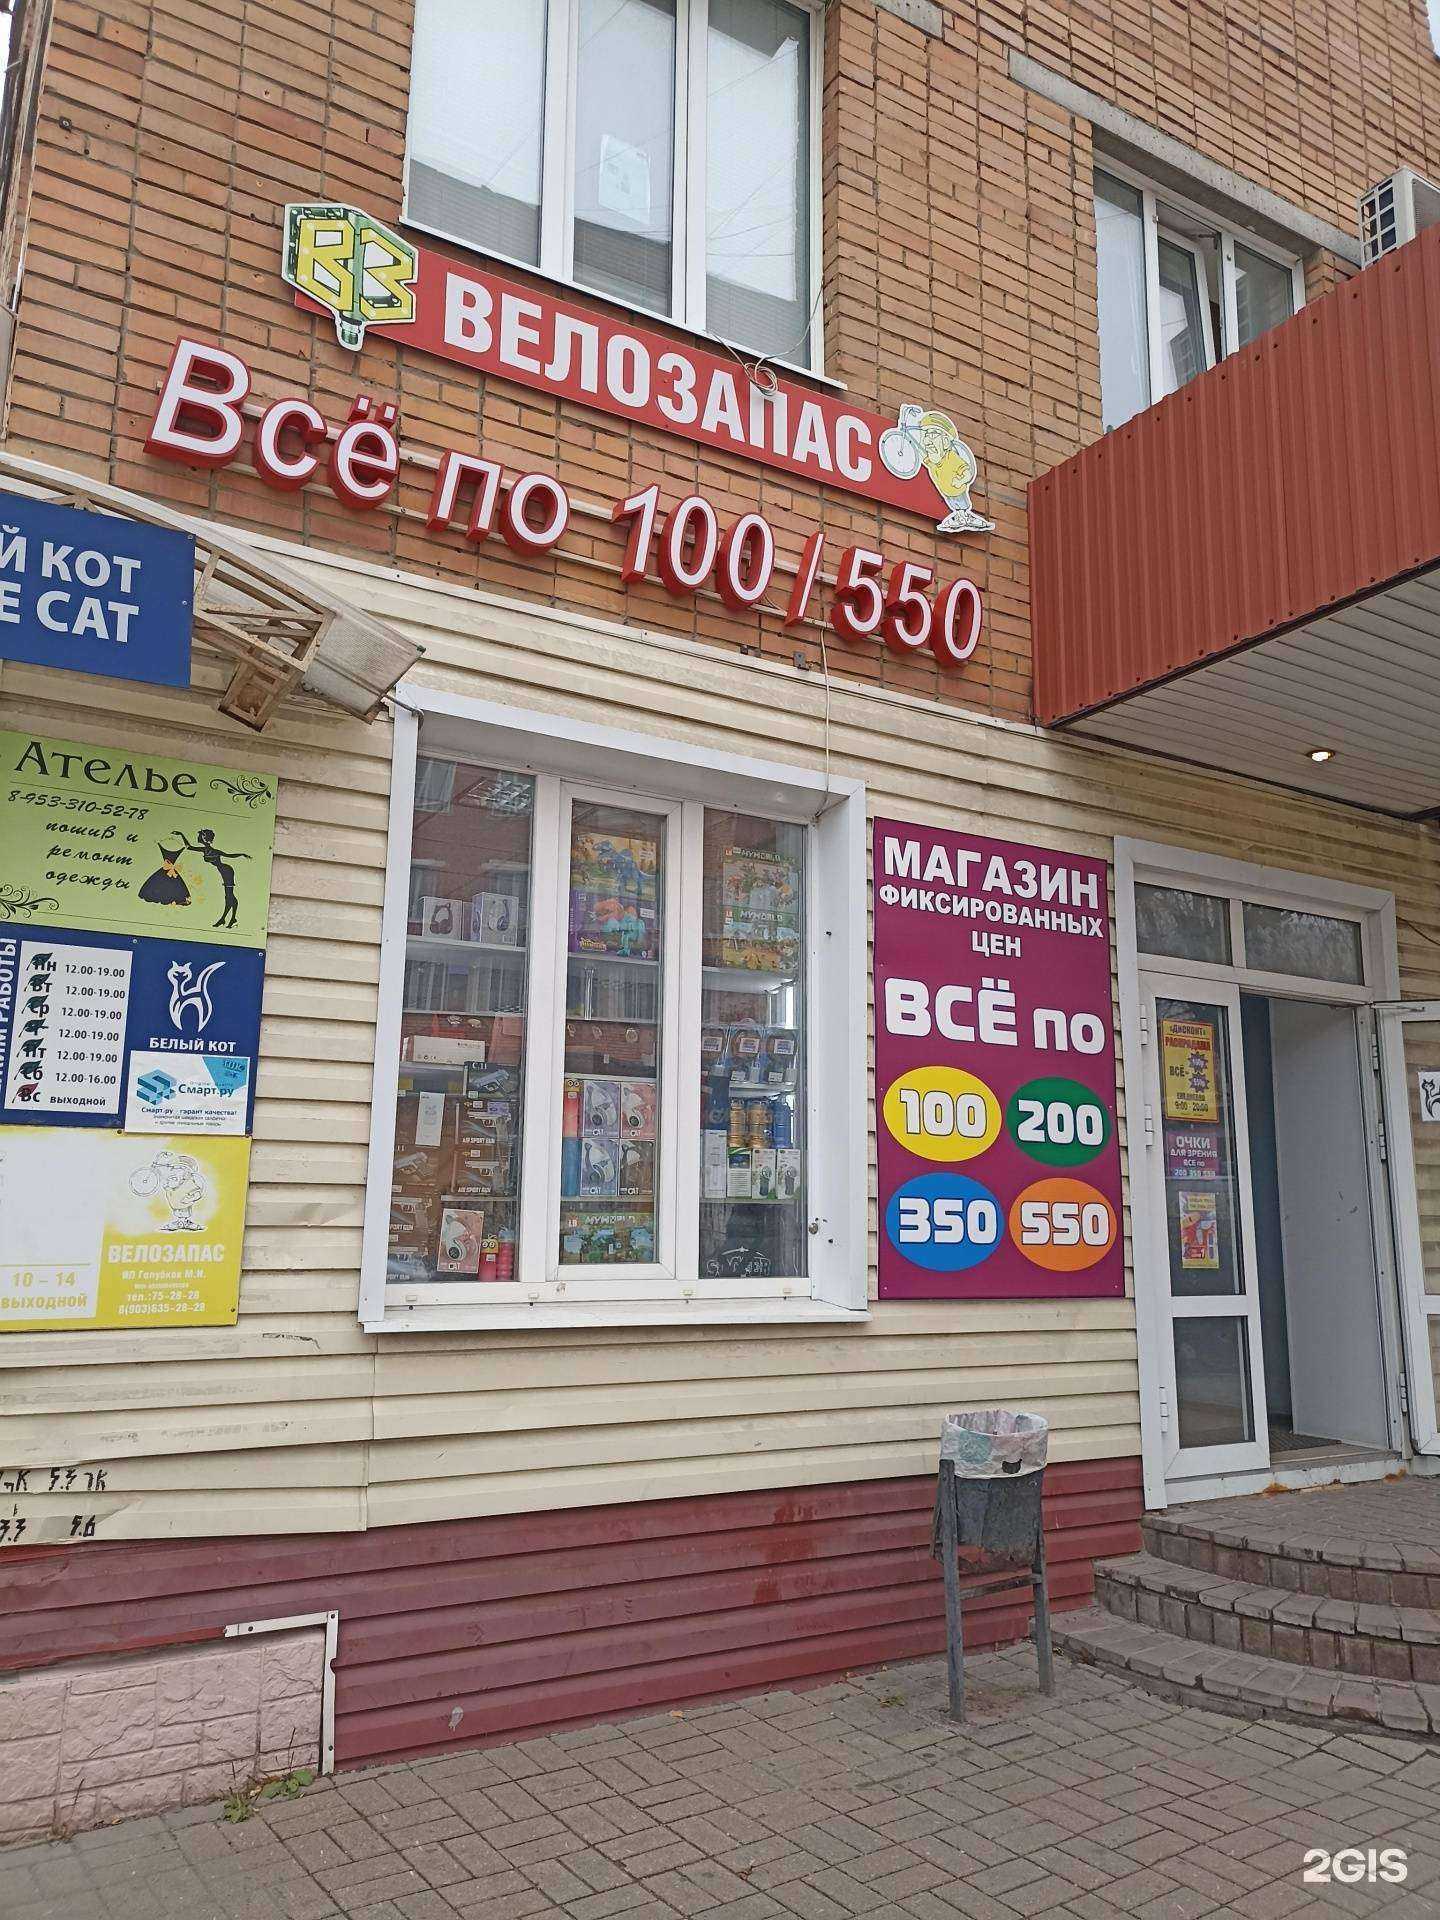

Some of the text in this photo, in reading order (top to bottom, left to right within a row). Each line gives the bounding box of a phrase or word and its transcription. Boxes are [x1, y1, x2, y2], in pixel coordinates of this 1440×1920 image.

[444, 272, 872, 482] ВЕЛОЗАПАС
[146, 336, 399, 505] Всё
[431, 450, 570, 551] по
[42, 541, 142, 593] КОТ
[36, 590, 140, 643] CAT
[14, 741, 198, 799] Ателье
[8, 790, 150, 820] 8-953-310-52-78
[46, 821, 139, 843] пошив и
[47, 844, 133, 867] ремонт
[46, 870, 130, 890] одежды
[883, 836, 1100, 910] МАГАЗИН
[878, 884, 1104, 938] ФИКСИРОВАННЫХ
[971, 930, 1022, 959] ЦЕН
[65, 964, 125, 978] 12.00-19.00
[65, 985, 126, 999] 12.00-19.00
[61, 1007, 122, 1020] 12.00-19.00
[884, 978, 1019, 1046] ВСЁ
[58, 1028, 120, 1042] 12.00-19.00
[149, 1037, 236, 1053] БЕЛЫЙ КОТ
[57, 1050, 118, 1063] 12.00-19.00
[55, 1072, 116, 1085] 12.00-16.00
[178, 1084, 234, 1097] Смарт.ру
[49, 1096, 106, 1106] выходной
[898, 1089, 1104, 1146] 100 200
[1176, 1136, 1211, 1149] ОЧКИ
[1170, 1149, 1217, 1158] ДЛЯ ЗРЕНИЯ
[898, 1195, 1111, 1246] 350 550
[108, 1244, 225, 1263] ВЕЛОЗАПАС
[12, 1272, 33, 1288] 10
[56, 1272, 77, 1287] 14
[0, 1293, 88, 1309] выходной
